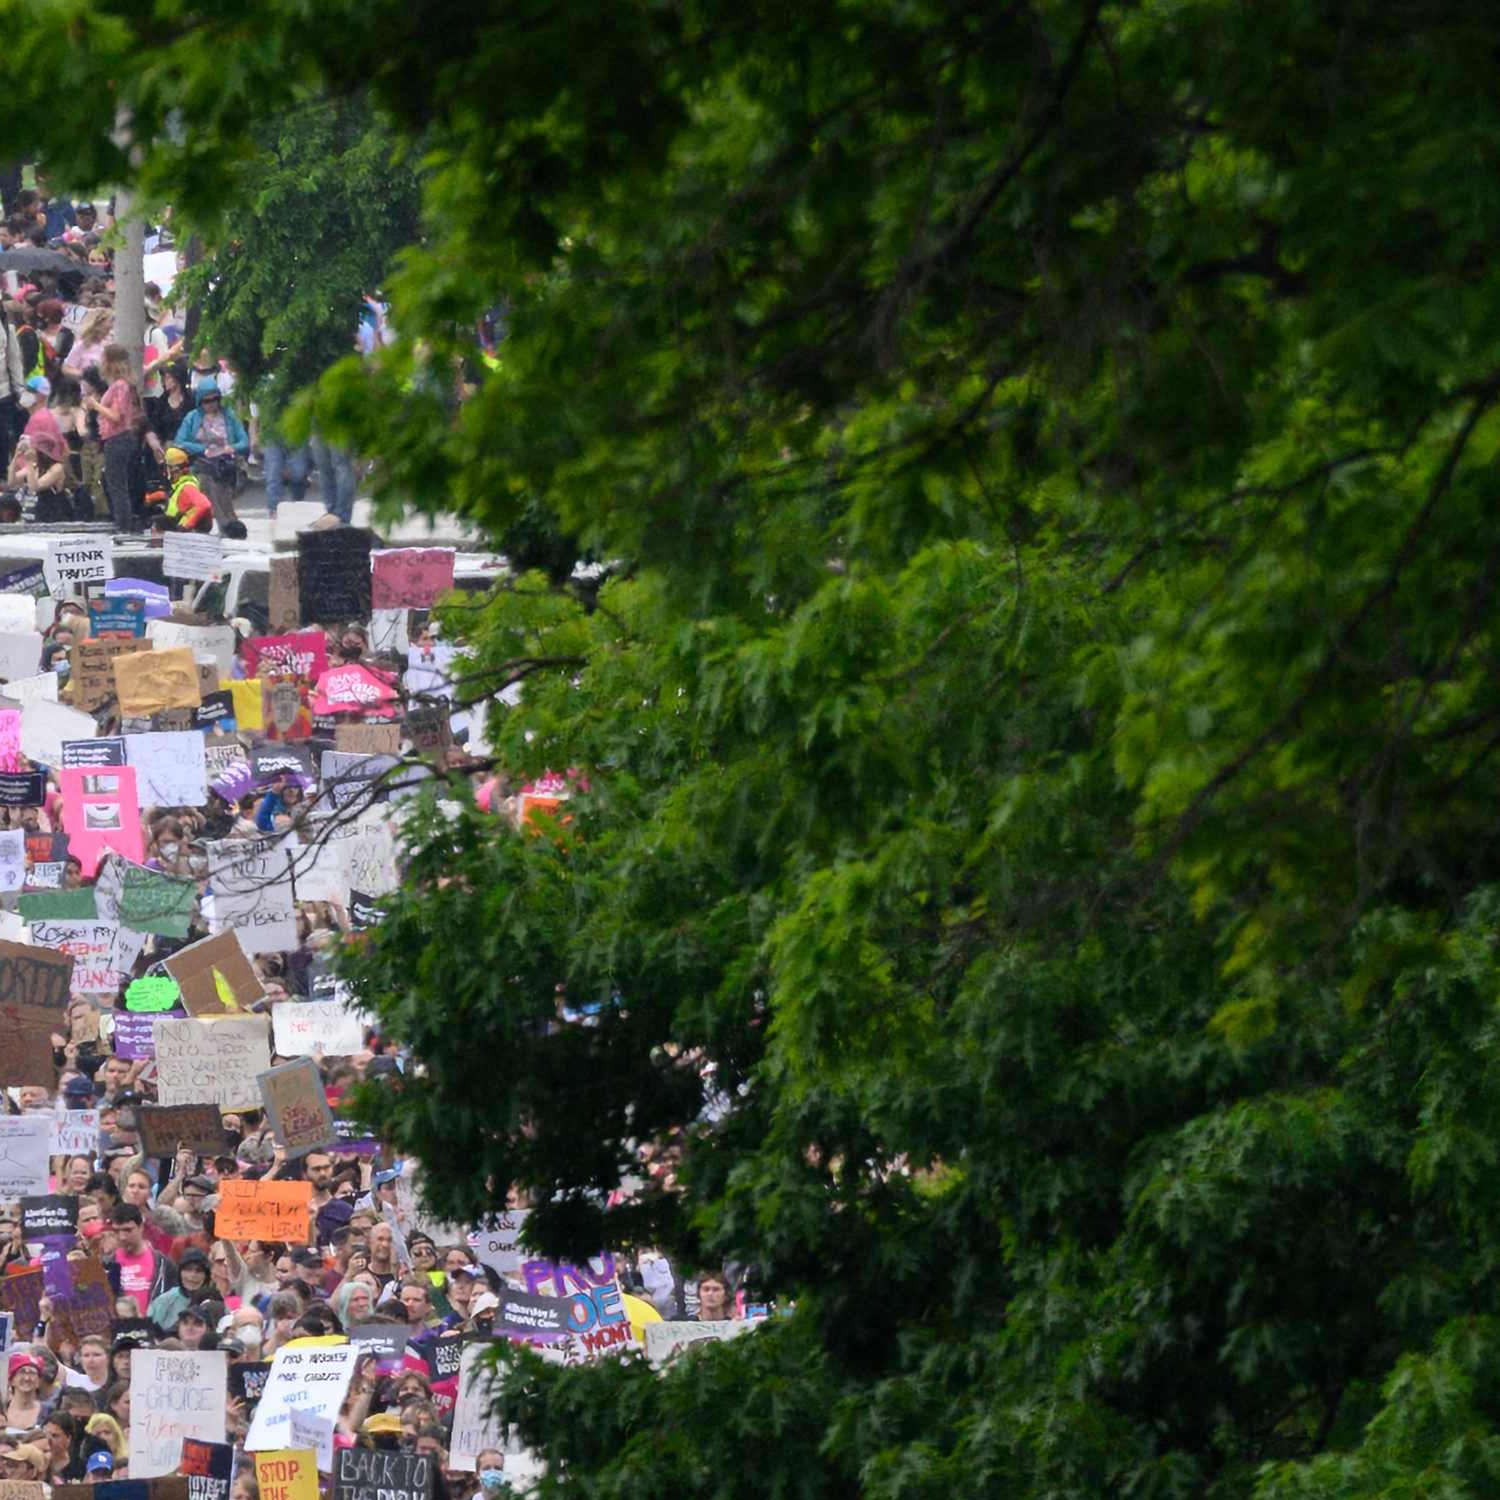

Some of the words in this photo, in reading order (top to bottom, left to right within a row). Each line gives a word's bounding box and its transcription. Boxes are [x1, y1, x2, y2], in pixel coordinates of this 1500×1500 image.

[55, 551, 104, 565] THINK
[340, 1449, 394, 1482] BACK
[399, 1453, 428, 1479] TO
